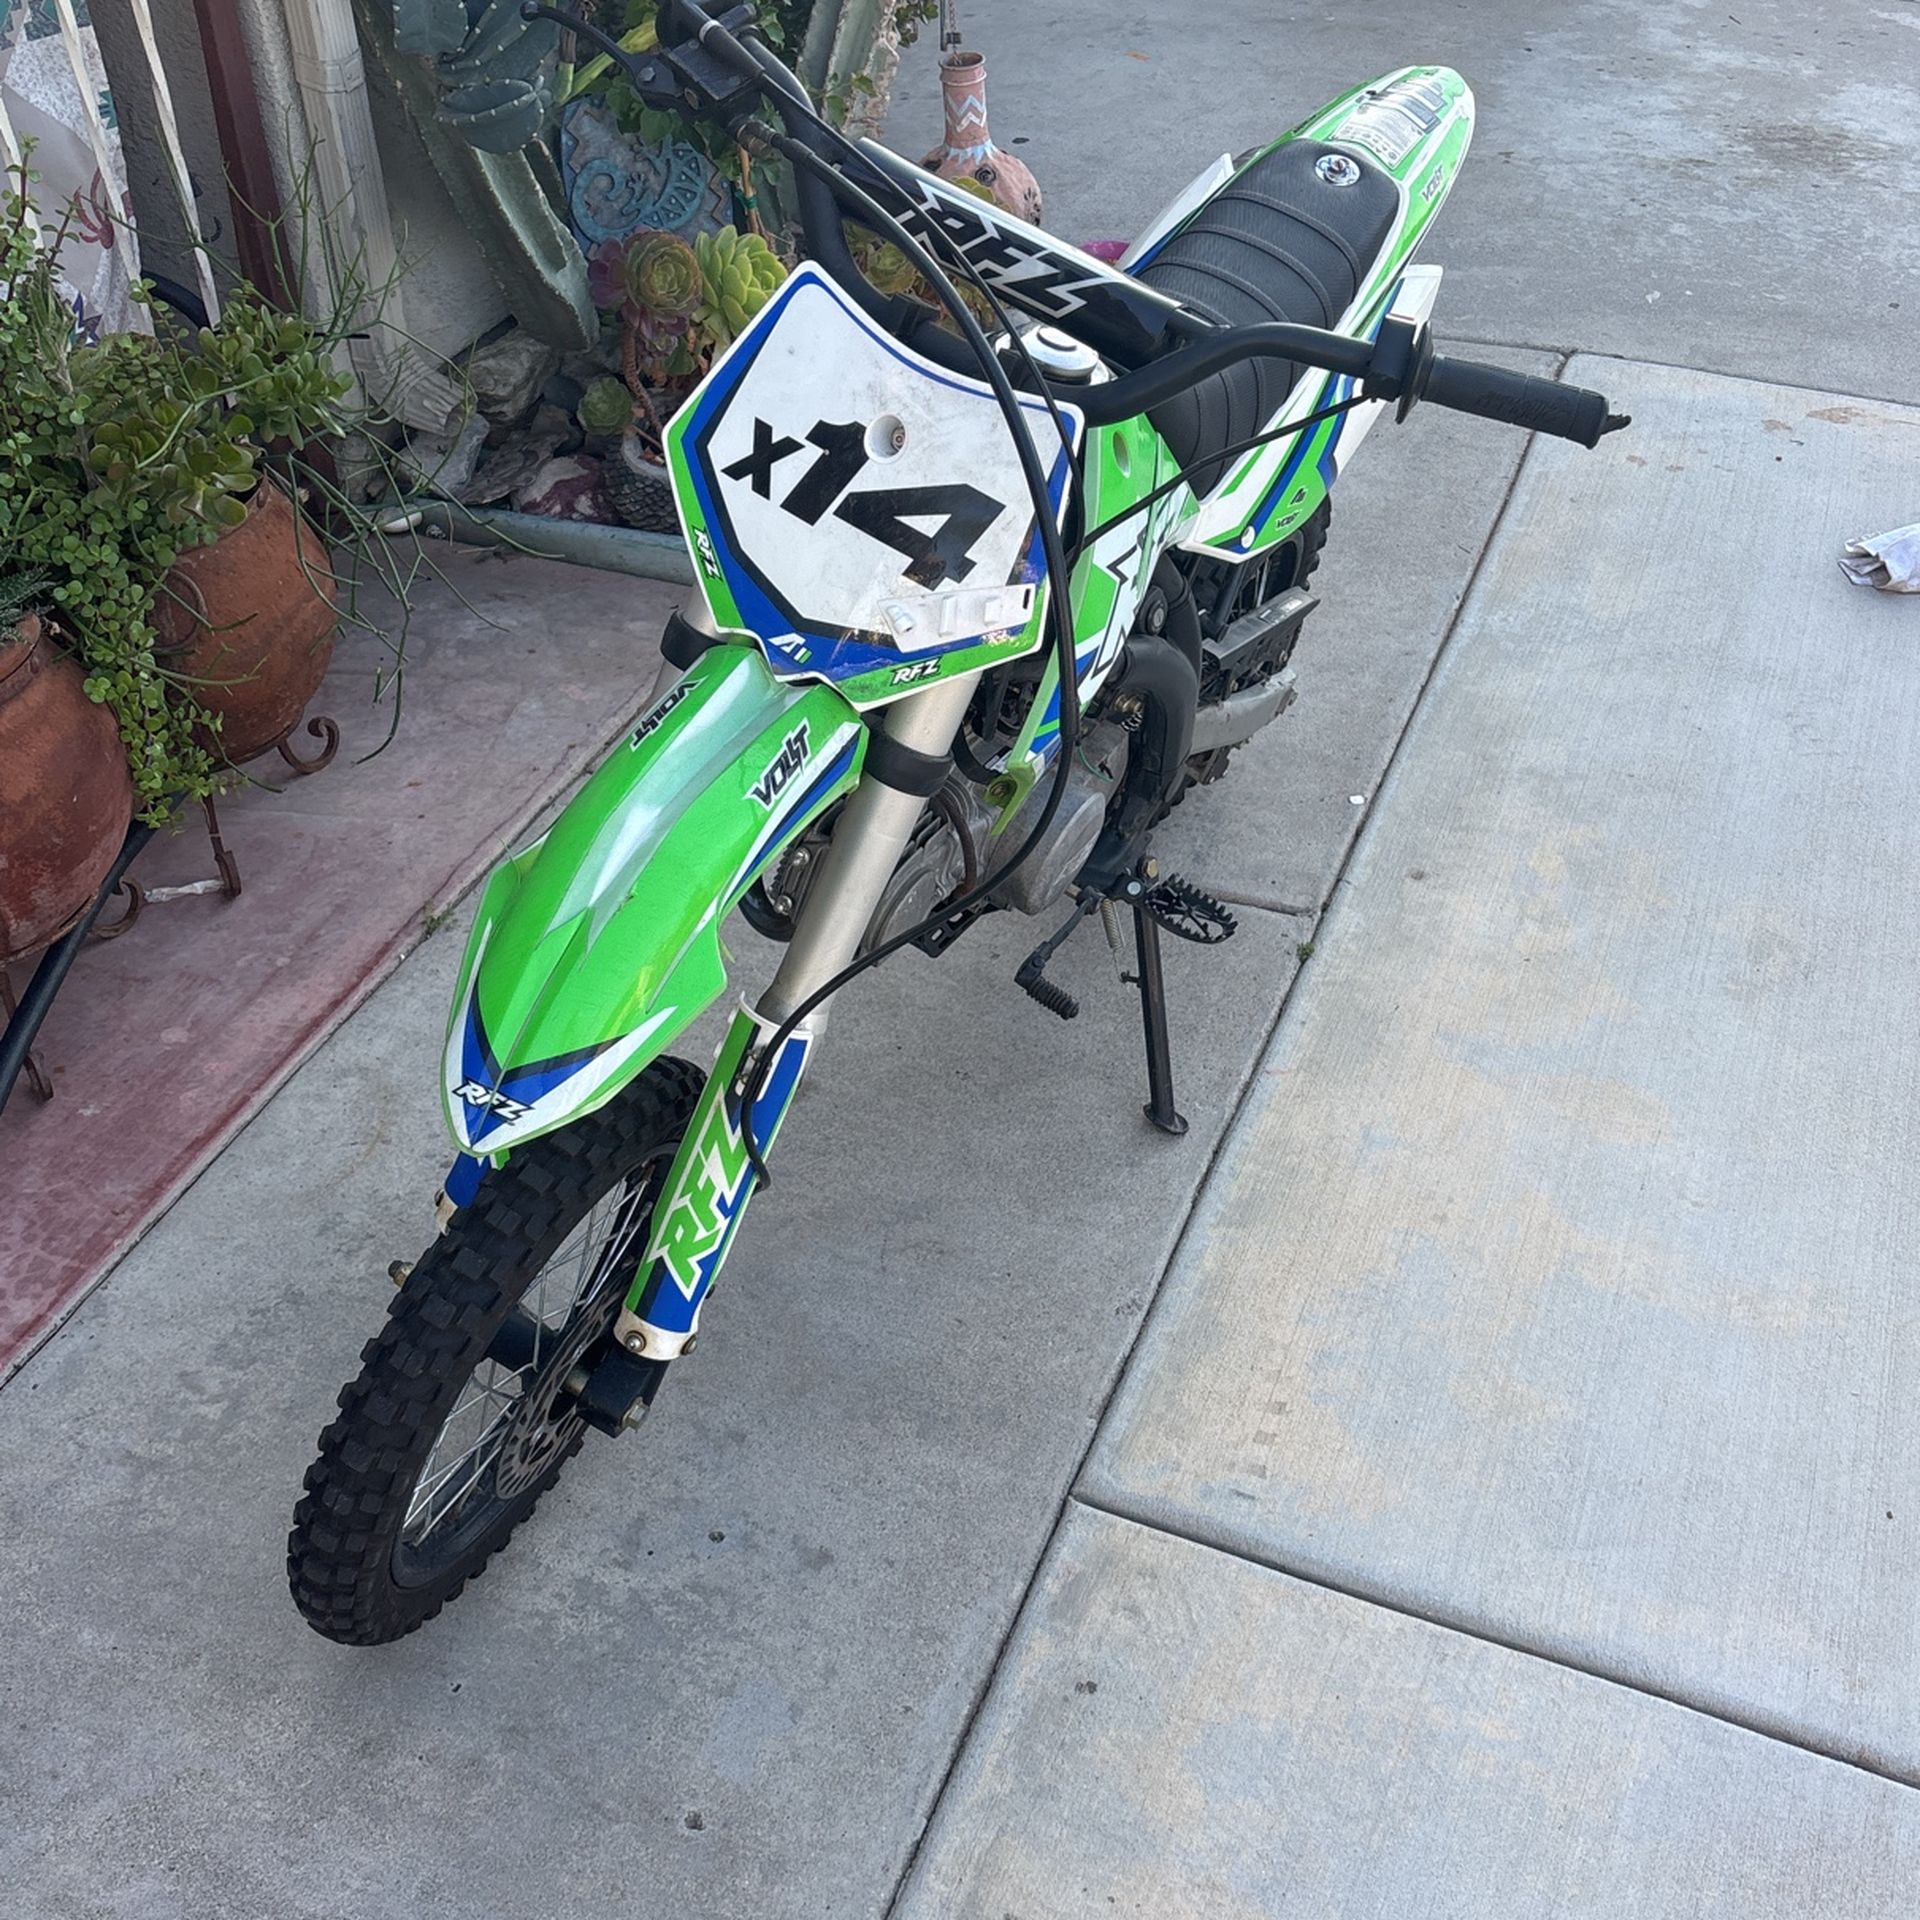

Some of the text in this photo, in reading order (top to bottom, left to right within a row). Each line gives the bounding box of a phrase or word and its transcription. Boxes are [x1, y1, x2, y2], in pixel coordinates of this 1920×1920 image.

[692, 525, 723, 581] RFZ
[890, 656, 941, 686] RFZ
[632, 680, 703, 748] VOLT
[748, 719, 812, 810] VOLT
[453, 1078, 535, 1121] RFZ
[648, 1084, 752, 1301] RFZ
